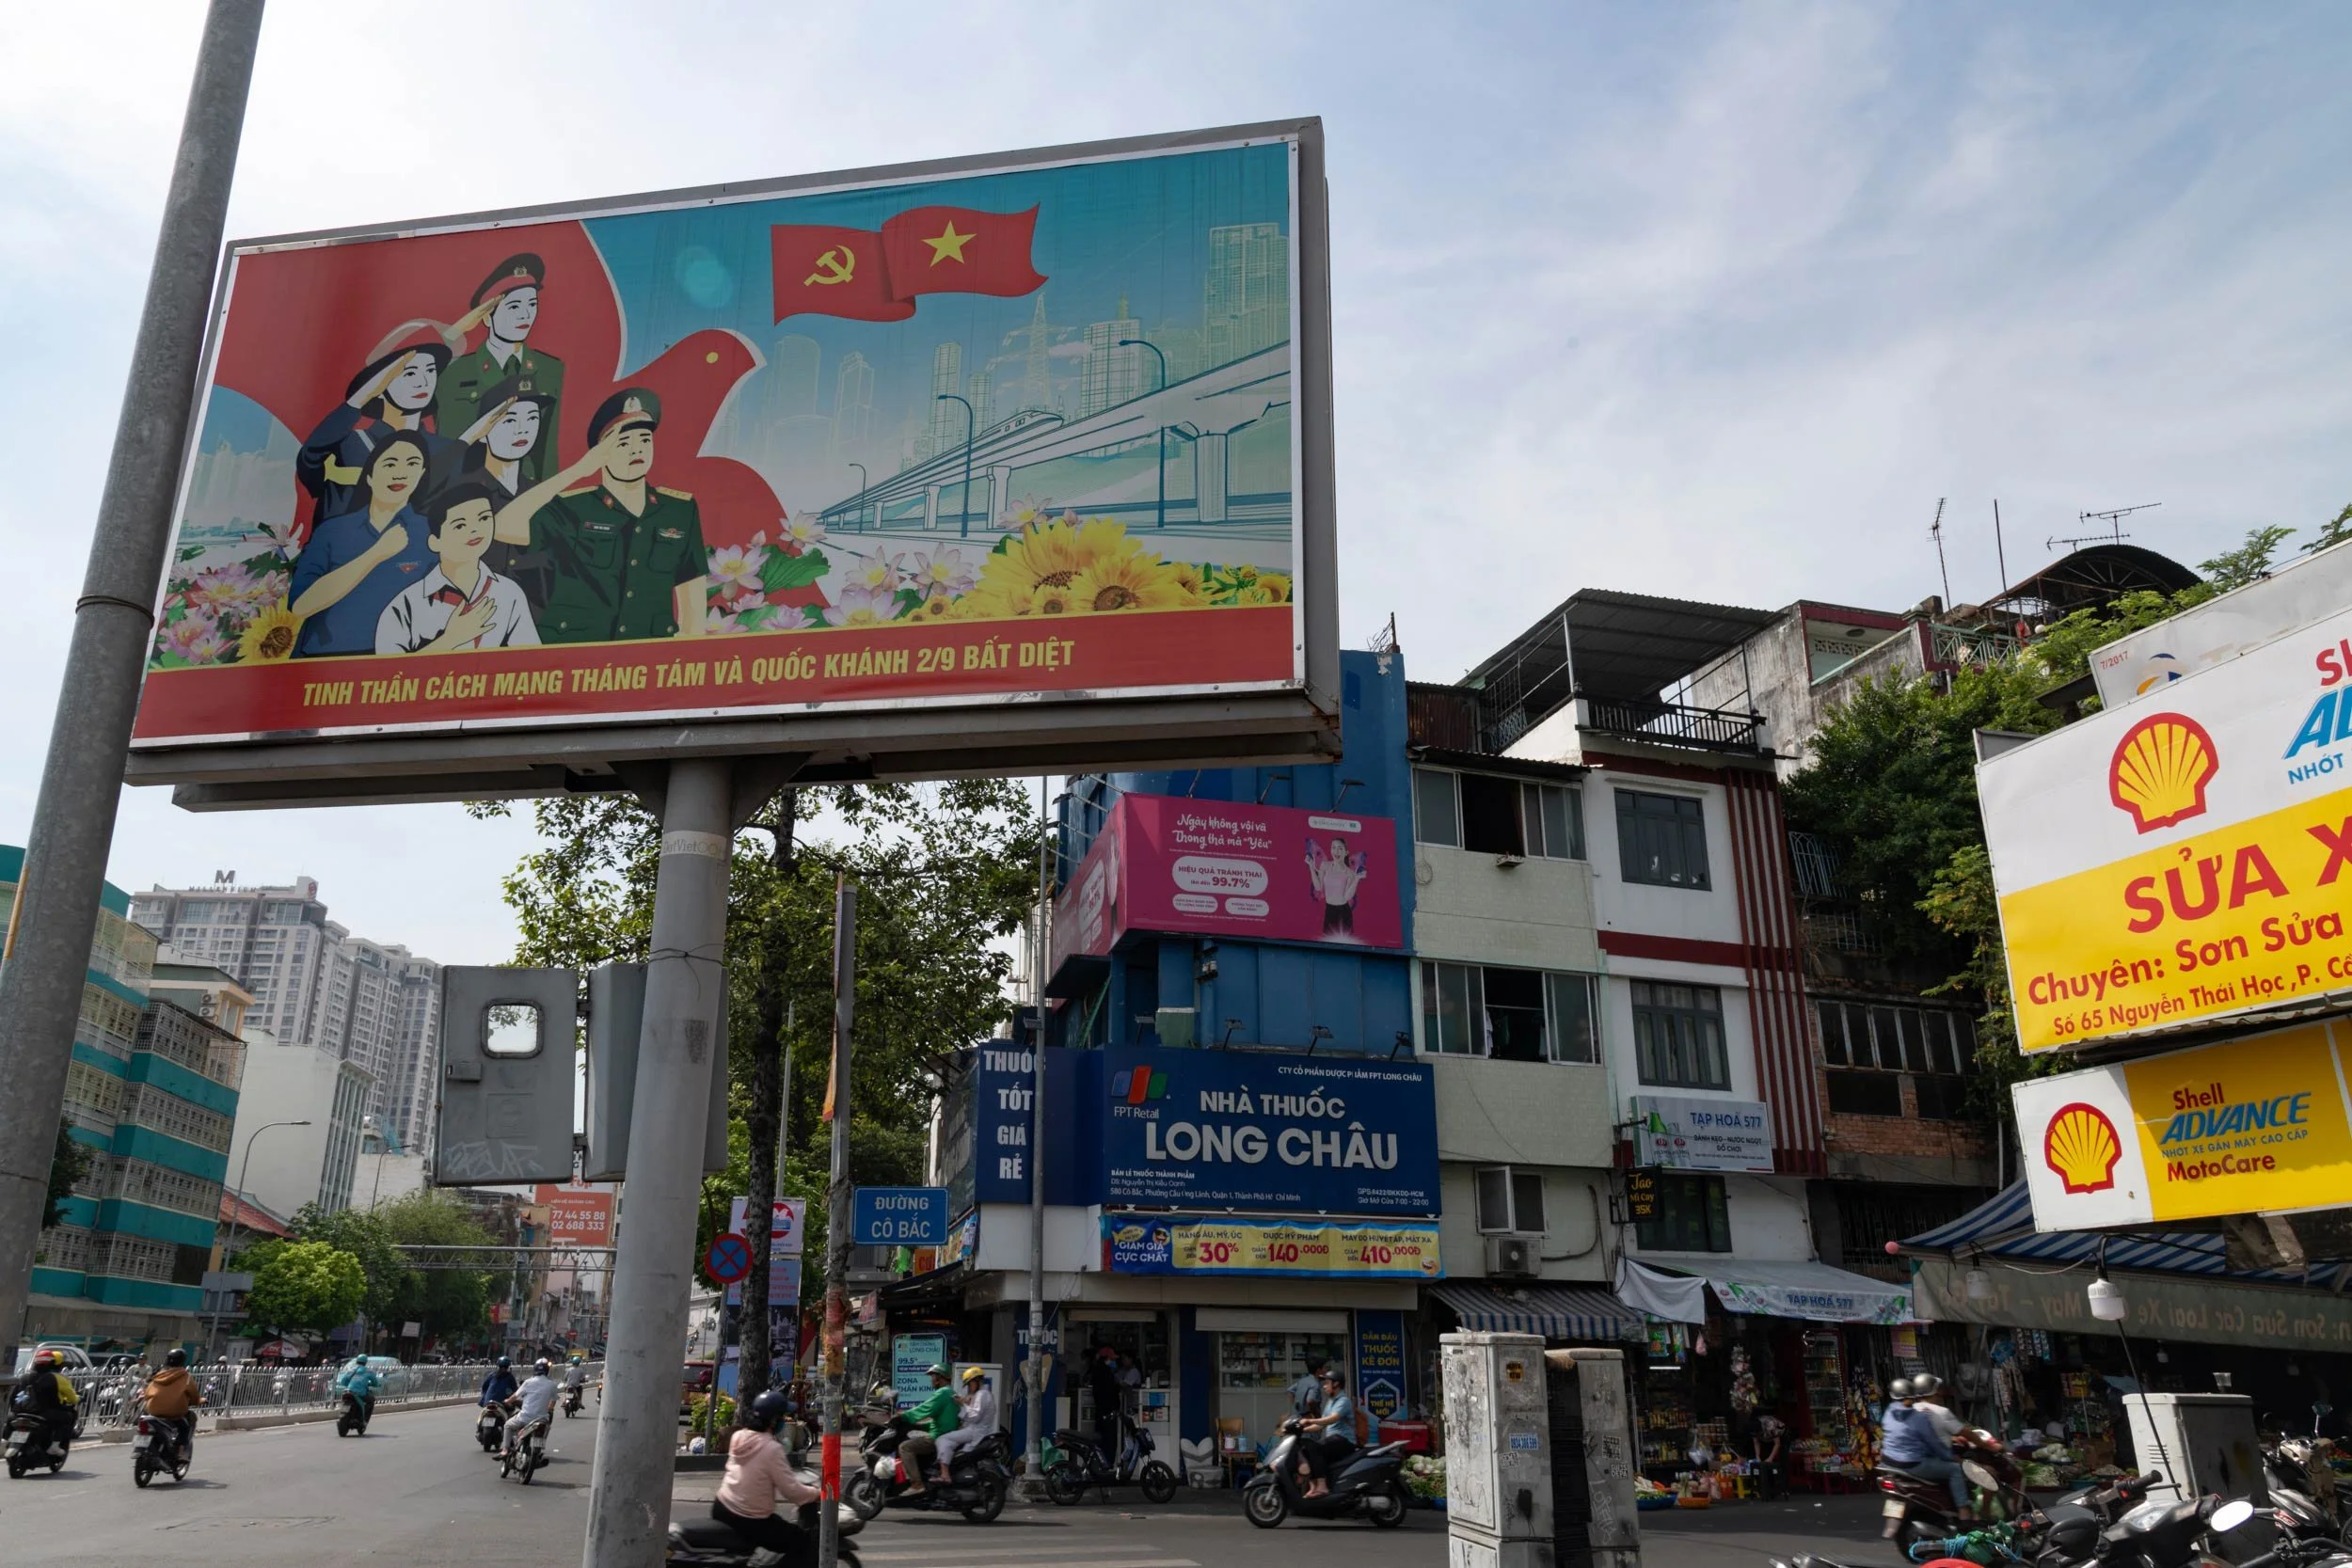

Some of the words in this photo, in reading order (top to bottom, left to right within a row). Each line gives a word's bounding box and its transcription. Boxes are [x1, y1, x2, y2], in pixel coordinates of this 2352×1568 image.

[2101, 651, 2128, 669] 7/2017
[302, 681, 354, 706] TINH
[360, 672, 420, 705] THẦN
[423, 671, 485, 702] CÁCH
[492, 672, 564, 701] MẠNG
[571, 663, 648, 693] THÁNG
[656, 658, 707, 688] TÁM
[714, 656, 743, 685] VÀ
[751, 647, 817, 685] QUỐC
[824, 646, 910, 678] KHÁNH
[916, 646, 957, 673] 2/9
[963, 636, 1012, 671] BẤT
[1019, 636, 1075, 672] DIỆT
[2288, 752, 2344, 784] NHỚT
[1177, 814, 1207, 832] Ngày
[1208, 816, 1239, 835] không
[1240, 820, 1254, 833] vội
[1255, 822, 1267, 832] vã
[1171, 830, 1207, 849] Thong
[1208, 833, 1225, 847] thả
[1227, 836, 1243, 847] mà
[215, 870, 235, 883] M
[1178, 865, 1197, 874] HIỆU
[1199, 866, 1216, 876] QUẢ
[1217, 868, 1243, 878] TRÁNH
[1212, 876, 1250, 889] 99.7%
[2124, 844, 2290, 934] SỬA
[2027, 958, 2165, 1006] Chuyên:
[2176, 935, 2249, 972] Sơn
[2260, 912, 2344, 952] Sửa
[2054, 1013, 2075, 1036] Số
[2081, 1010, 2104, 1031] 65
[2109, 993, 2185, 1027] Nguyễn
[2189, 981, 2236, 1008] Thái
[2241, 974, 2285, 998] Học
[1278, 1066, 1293, 1075] CTY
[1326, 1069, 1346, 1079] DƯỢC
[1369, 1071, 1382, 1081] FPT
[1383, 1072, 1402, 1082] LONG
[1403, 1072, 1422, 1083] CHÂU
[997, 1082, 1033, 1111] TỐT
[1200, 1084, 1255, 1115] NHÀ
[1260, 1085, 1345, 1119] THUỐC
[2173, 1082, 2225, 1110] Shell
[1114, 1106, 1133, 1117] FPT
[1134, 1107, 1159, 1119] Retail
[1691, 1113, 1712, 1129] TẠP
[1744, 1116, 1762, 1128] 577
[2159, 1091, 2312, 1145] ADVANCE
[996, 1123, 1026, 1146] GIÁ
[2261, 1132, 2284, 1145] CAO
[1146, 1121, 1269, 1164] LONG
[1277, 1121, 1398, 1170] CHÂU
[998, 1153, 1024, 1180] RẺ
[1133, 1167, 1154, 1178] THUỐC
[2168, 1154, 2276, 1181] MotoCare
[875, 1195, 930, 1211] ĐƯỜNG
[1633, 1204, 1652, 1215] 35K
[564, 1211, 578, 1221] 44
[580, 1211, 591, 1221] 55
[871, 1217, 893, 1239] CÔ
[898, 1212, 931, 1239] BẮC
[1114, 1251, 1138, 1264] CỰC
[1139, 1249, 1169, 1263] CHẤT
[1363, 1341, 1398, 1354] THUỐC
